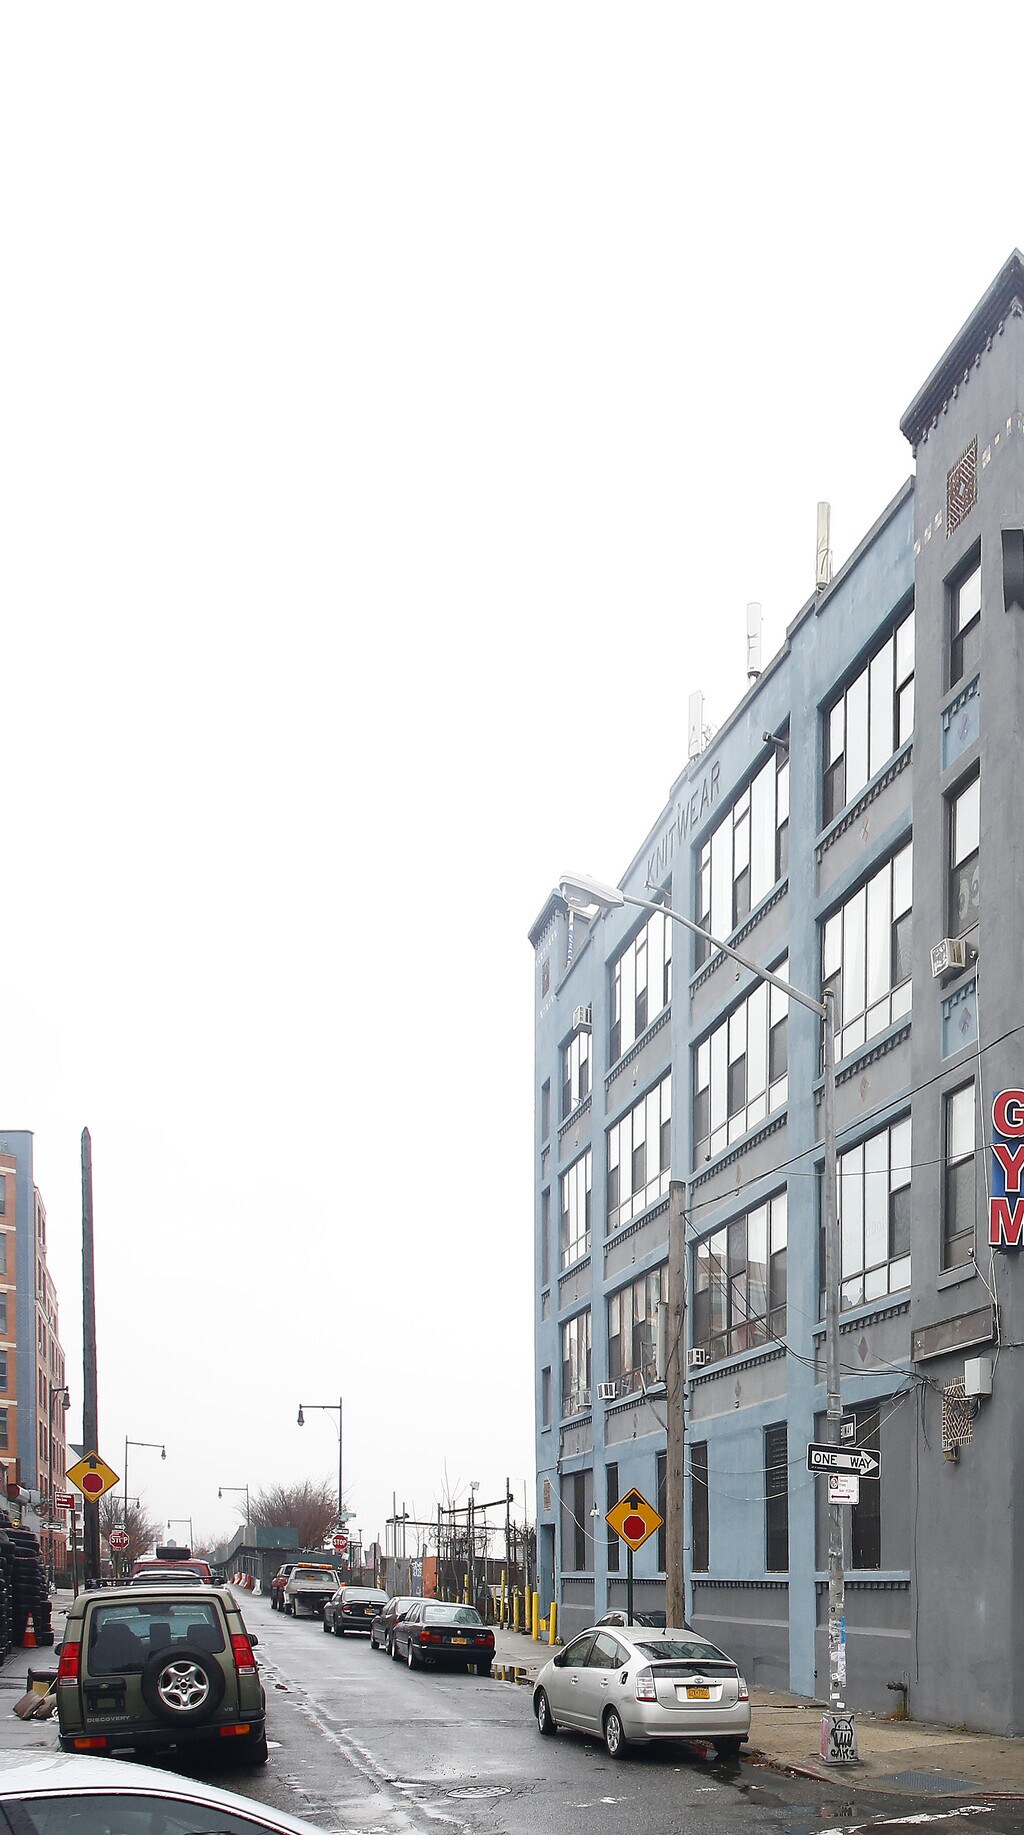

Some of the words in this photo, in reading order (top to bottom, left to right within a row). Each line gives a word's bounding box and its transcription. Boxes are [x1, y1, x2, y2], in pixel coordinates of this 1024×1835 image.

[647, 759, 721, 883] KNITWEAR
[813, 1452, 838, 1465] ONE
[849, 1456, 873, 1469] WAY
[333, 1538, 347, 1546] STOP
[86, 1715, 130, 1723] DISCOVERY
